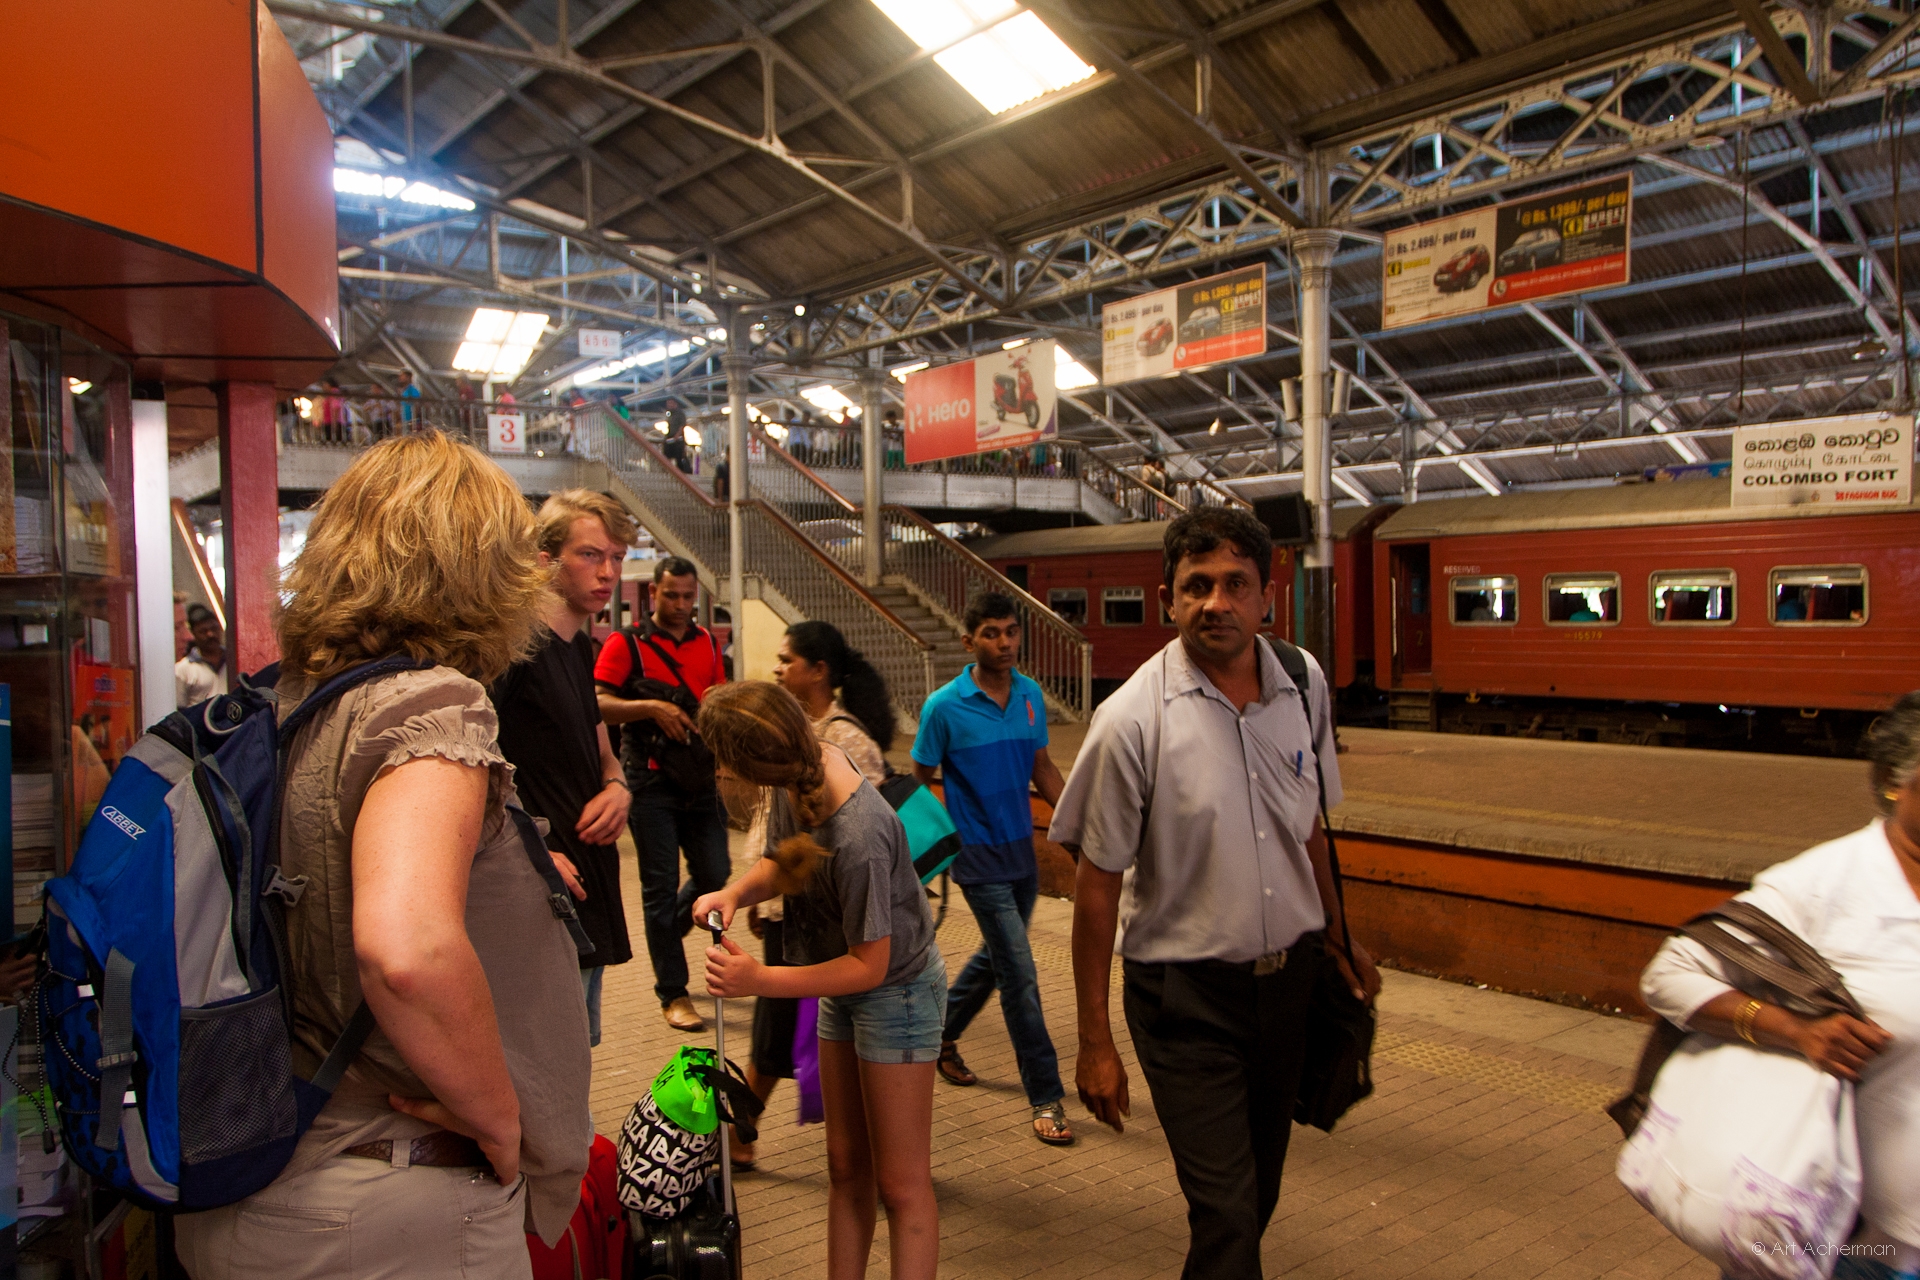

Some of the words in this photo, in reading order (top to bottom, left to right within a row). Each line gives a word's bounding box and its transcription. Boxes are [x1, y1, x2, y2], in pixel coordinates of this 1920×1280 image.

[500, 419, 515, 443] 3
[1743, 472, 1838, 486] COLOMBO
[1844, 469, 1899, 482] FORT
[1443, 565, 1481, 575] RESERVED
[106, 809, 145, 837] ABBEY
